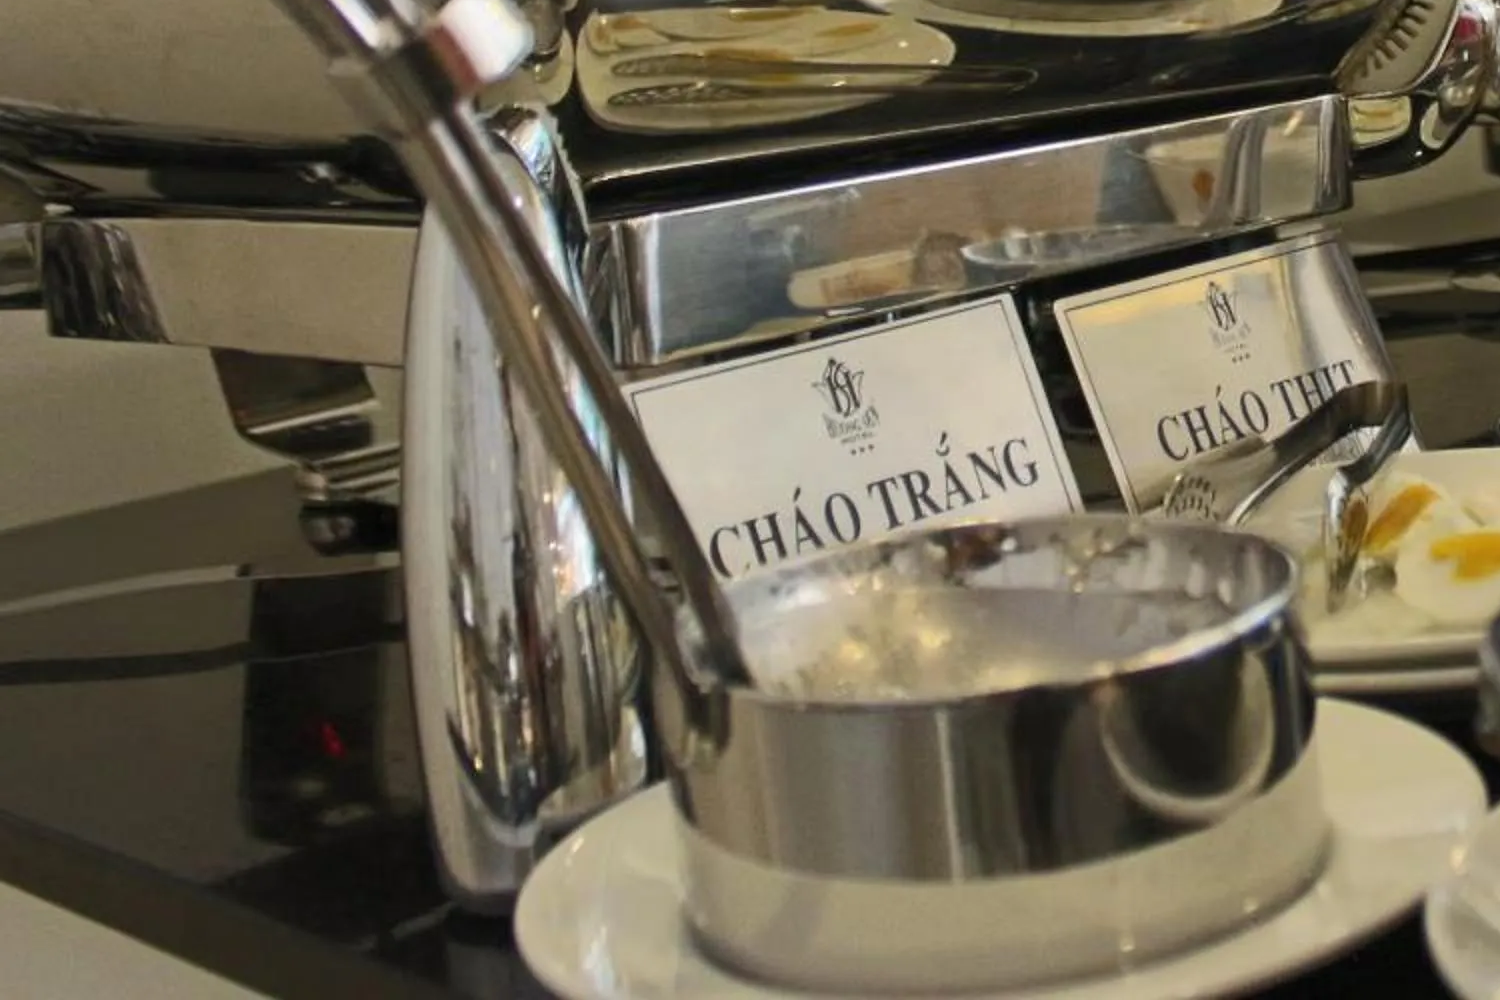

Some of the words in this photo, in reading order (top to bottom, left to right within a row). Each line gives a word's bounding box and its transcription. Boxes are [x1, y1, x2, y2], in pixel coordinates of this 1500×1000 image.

[1157, 384, 1269, 461] CHÁO
[708, 485, 862, 579] CHÁO
[866, 430, 1040, 532] TRẮNG
